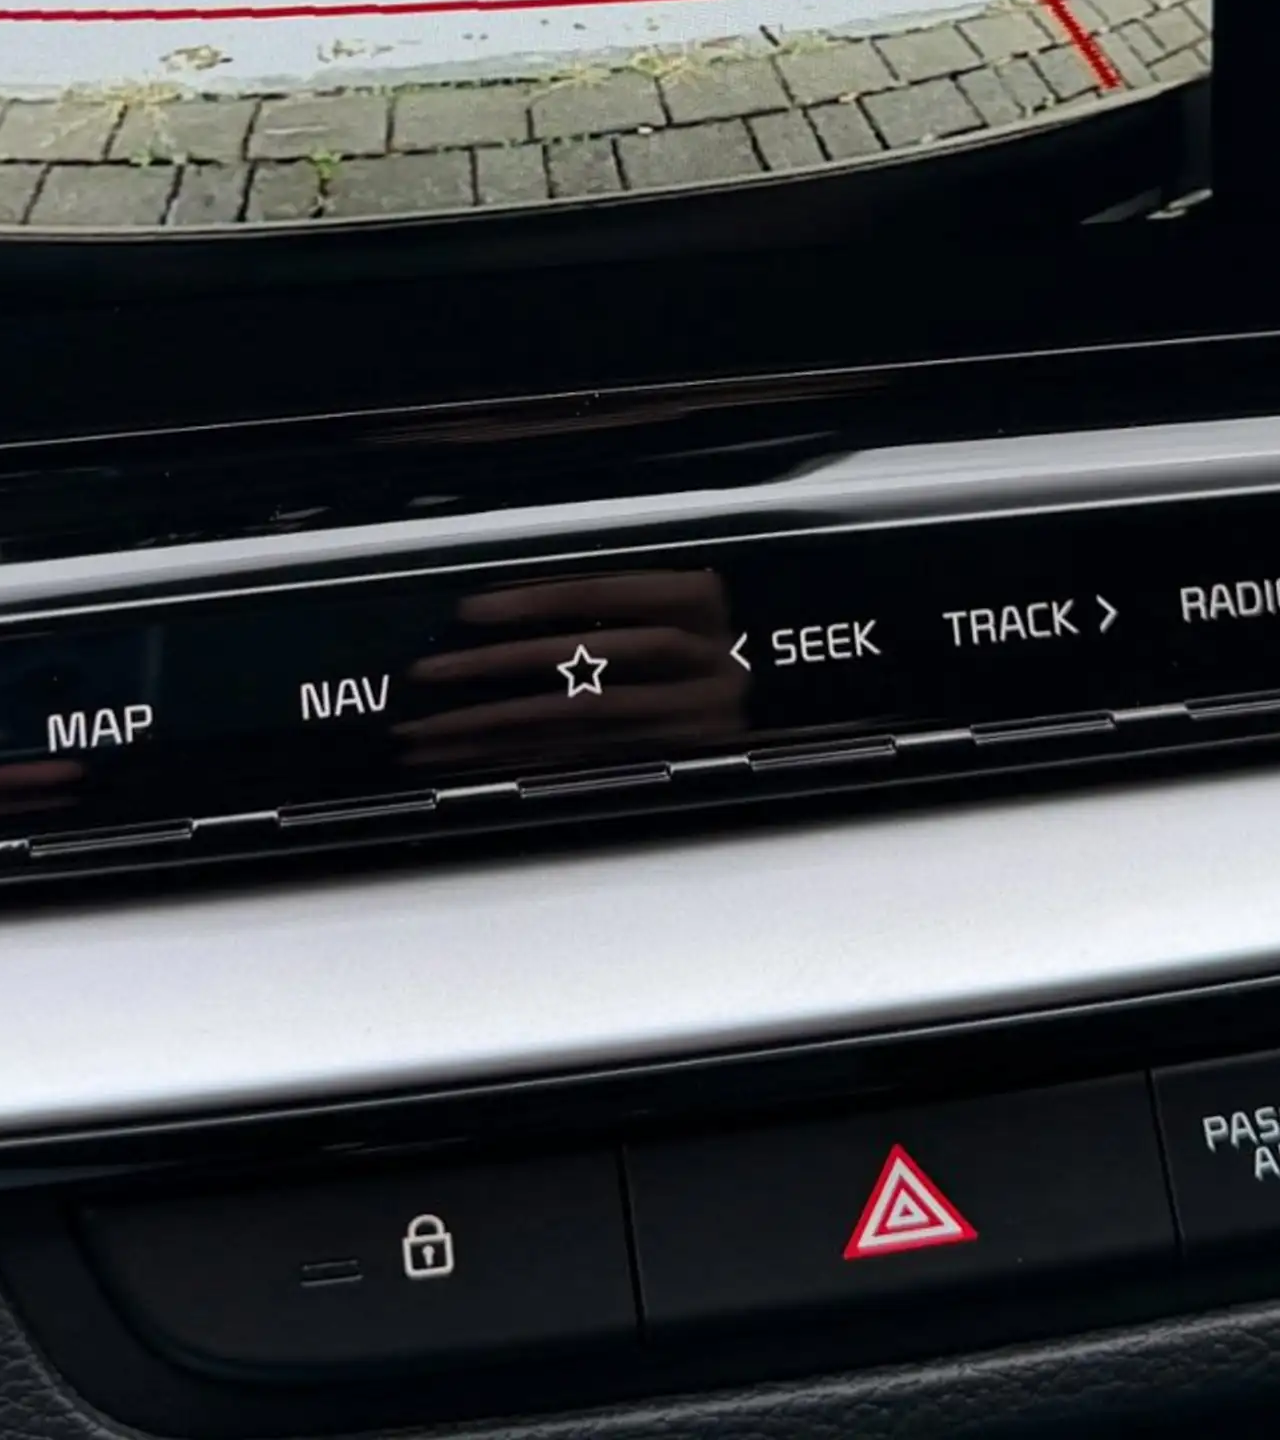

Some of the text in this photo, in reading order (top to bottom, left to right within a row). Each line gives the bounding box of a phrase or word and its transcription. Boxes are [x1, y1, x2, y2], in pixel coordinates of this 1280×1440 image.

[770, 618, 883, 667] SEEK
[942, 598, 1080, 648] TRACK
[299, 673, 391, 722] NAV
[46, 703, 154, 754] MAP
